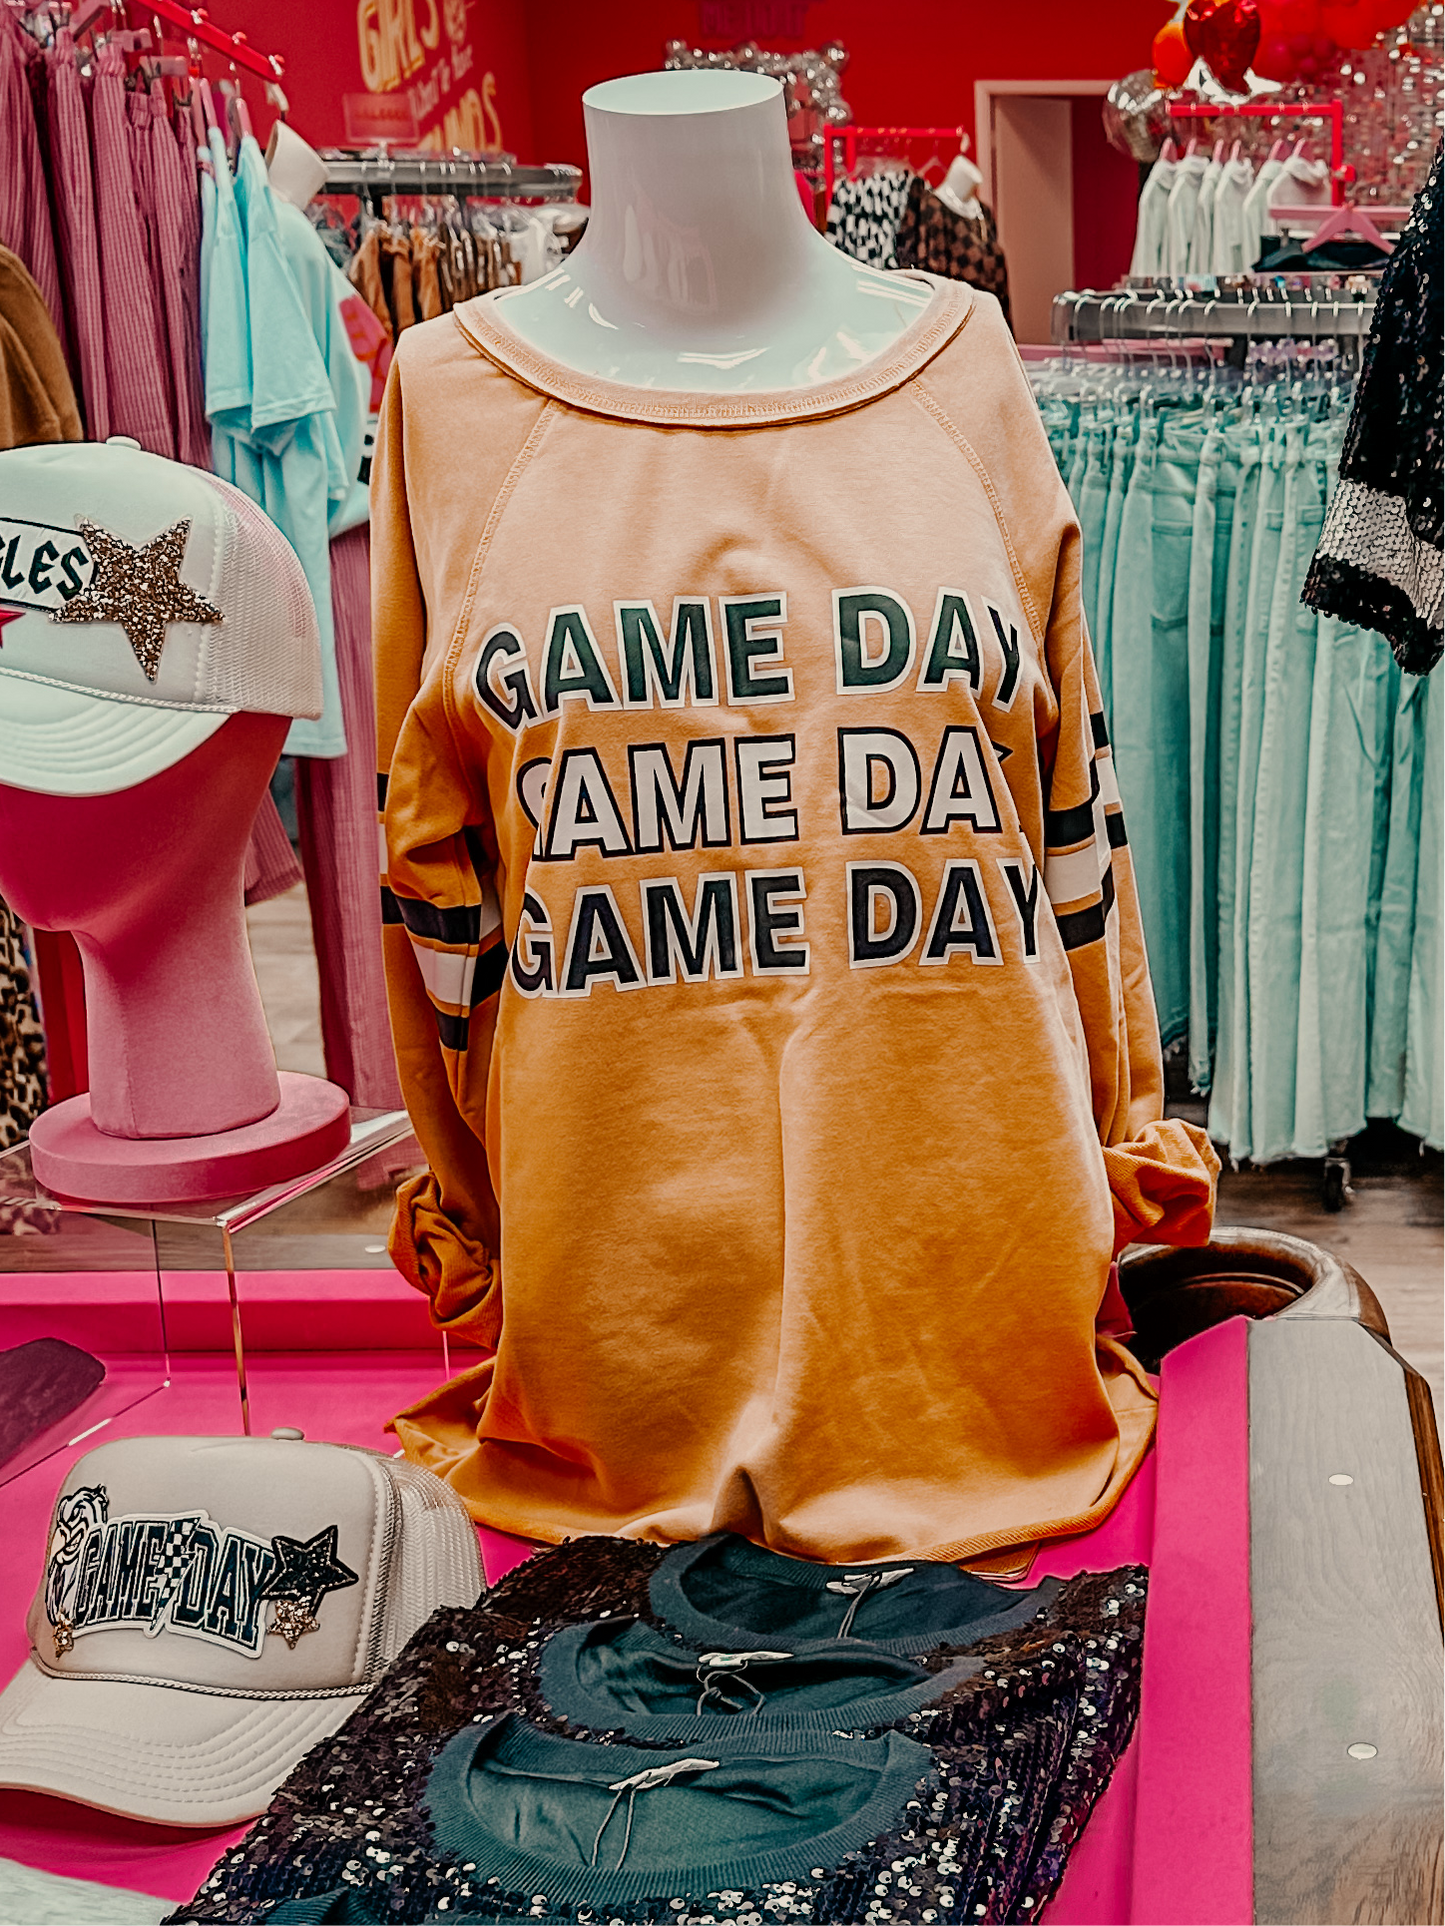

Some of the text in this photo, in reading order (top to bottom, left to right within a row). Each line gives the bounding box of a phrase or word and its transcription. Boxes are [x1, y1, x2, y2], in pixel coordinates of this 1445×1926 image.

[0, 533, 89, 601] LES
[472, 586, 1023, 736] GAME DAY
[838, 725, 1014, 836] DA
[509, 857, 1041, 999] GAME DAY
[73, 1520, 277, 1651] GAME DAY
